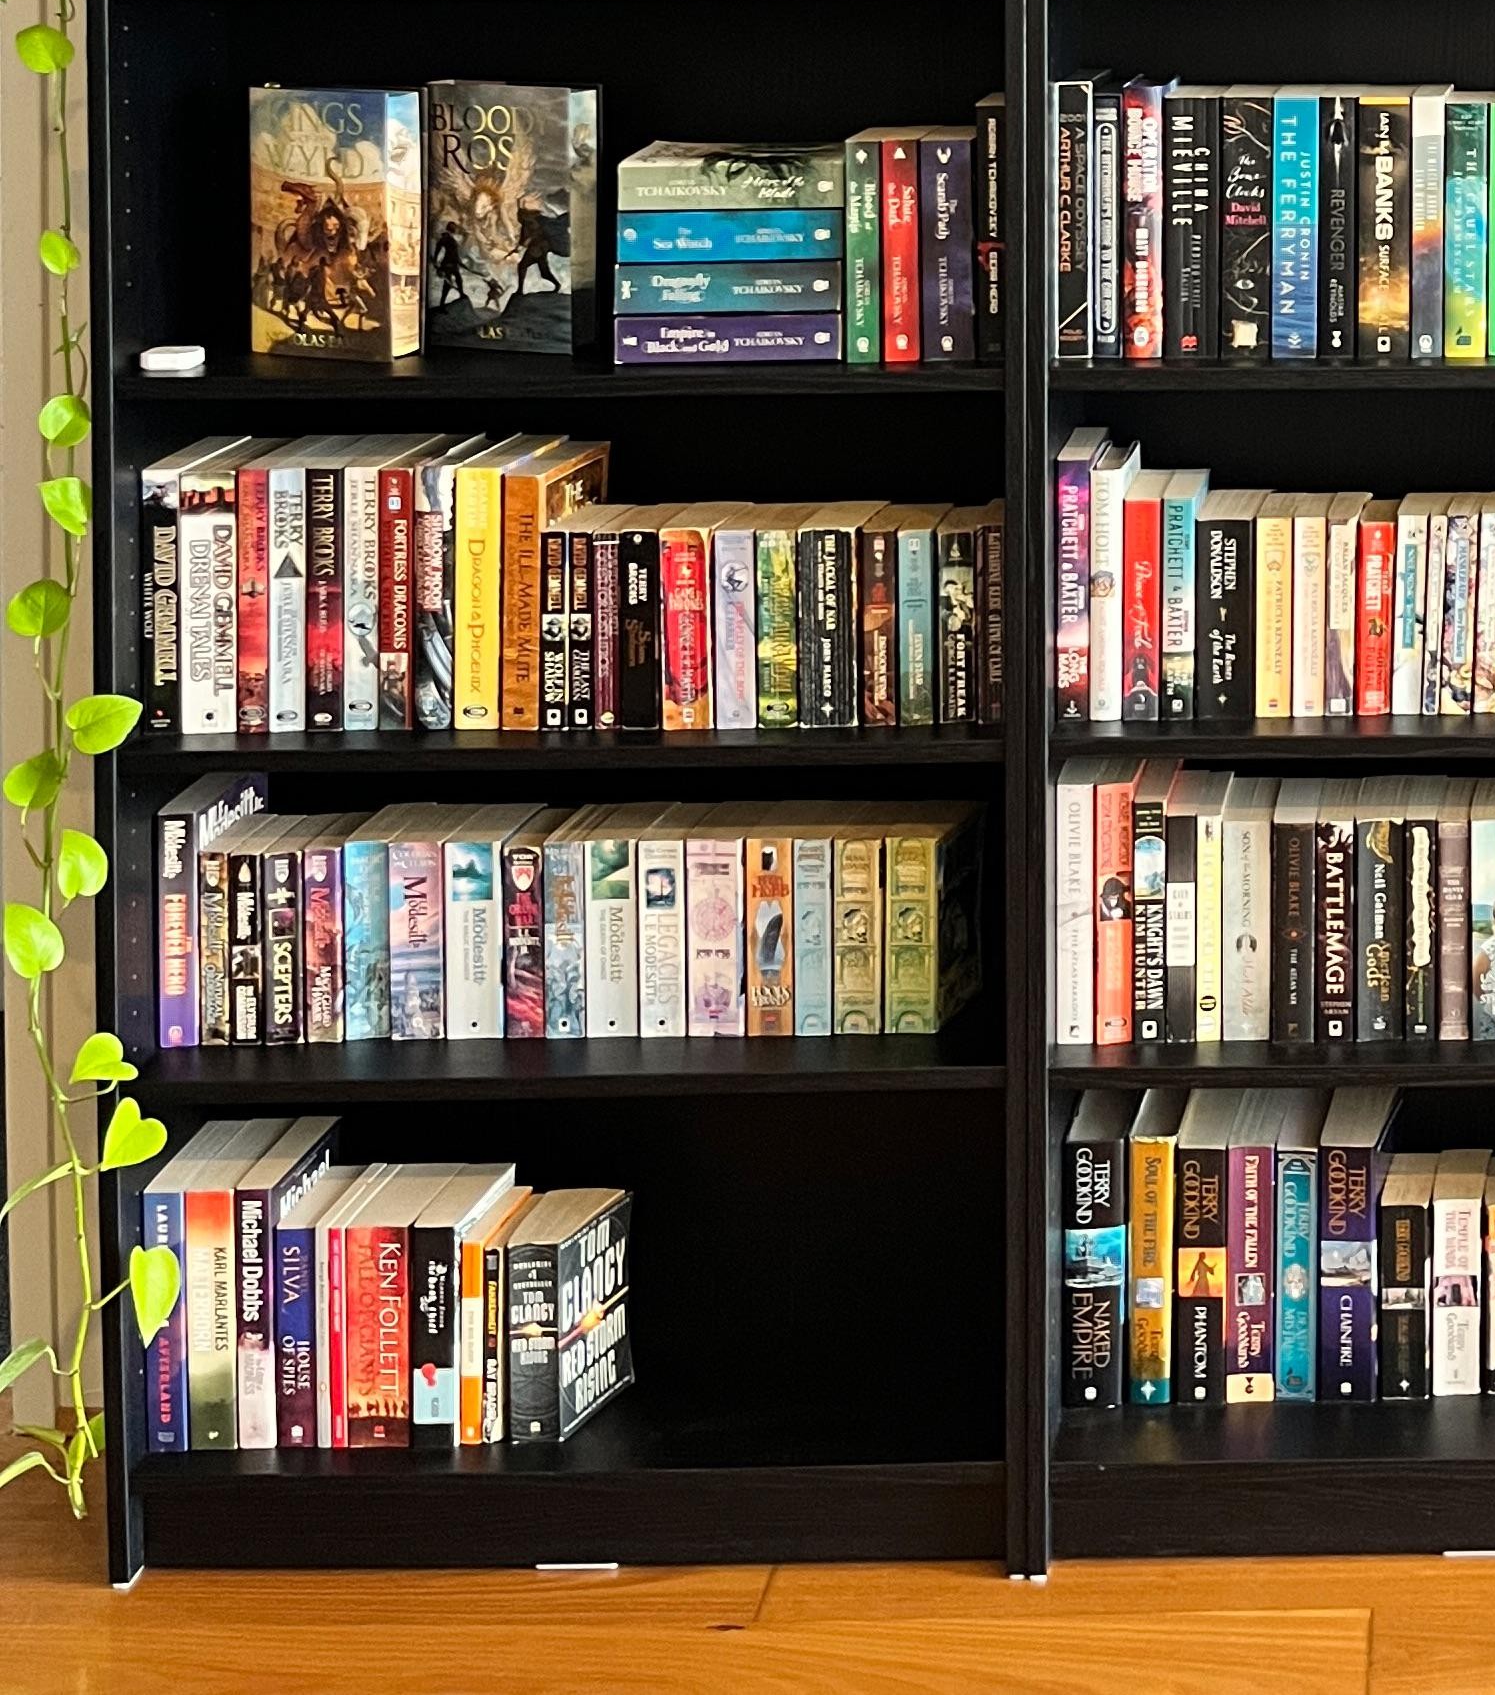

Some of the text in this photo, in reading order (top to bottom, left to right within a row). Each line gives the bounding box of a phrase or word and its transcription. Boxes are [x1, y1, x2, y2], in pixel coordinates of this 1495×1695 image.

[638, 187, 727, 196] TCHAIKOVSKY
[1194, 148, 1210, 212] CHINA
[1225, 215, 1266, 226] Mitchell
[1231, 204, 1261, 214] David
[1300, 152, 1311, 282] JUSTIN CRONIN
[1280, 178, 1296, 314] FERRYMAN
[1168, 505, 1183, 579] PRATCHETT
[1210, 530, 1222, 600] DONALDSON
[1224, 538, 1236, 590] STEPHEN
[214, 525, 234, 696] DAVID GEMMELL
[822, 638, 831, 698] JOHN MARCO
[659, 913, 673, 1005] LEGACIES
[1136, 904, 1145, 1009] KIM HUNTER
[1325, 852, 1345, 995] BATTLEMAGE
[272, 942, 293, 1024] SCEPTERS
[1076, 1148, 1092, 1224] GOODKIND
[214, 1247, 227, 1352] KARL MARLANTES
[242, 1200, 262, 1321] Michael Dobbs
[282, 1246, 299, 1304] SILVA
[561, 1238, 626, 1332] CLANCY
[377, 1242, 399, 1394] KEN FOLLETT
[1072, 1293, 1092, 1380] EMPIRE
[1193, 1307, 1207, 1378] PHANTOM
